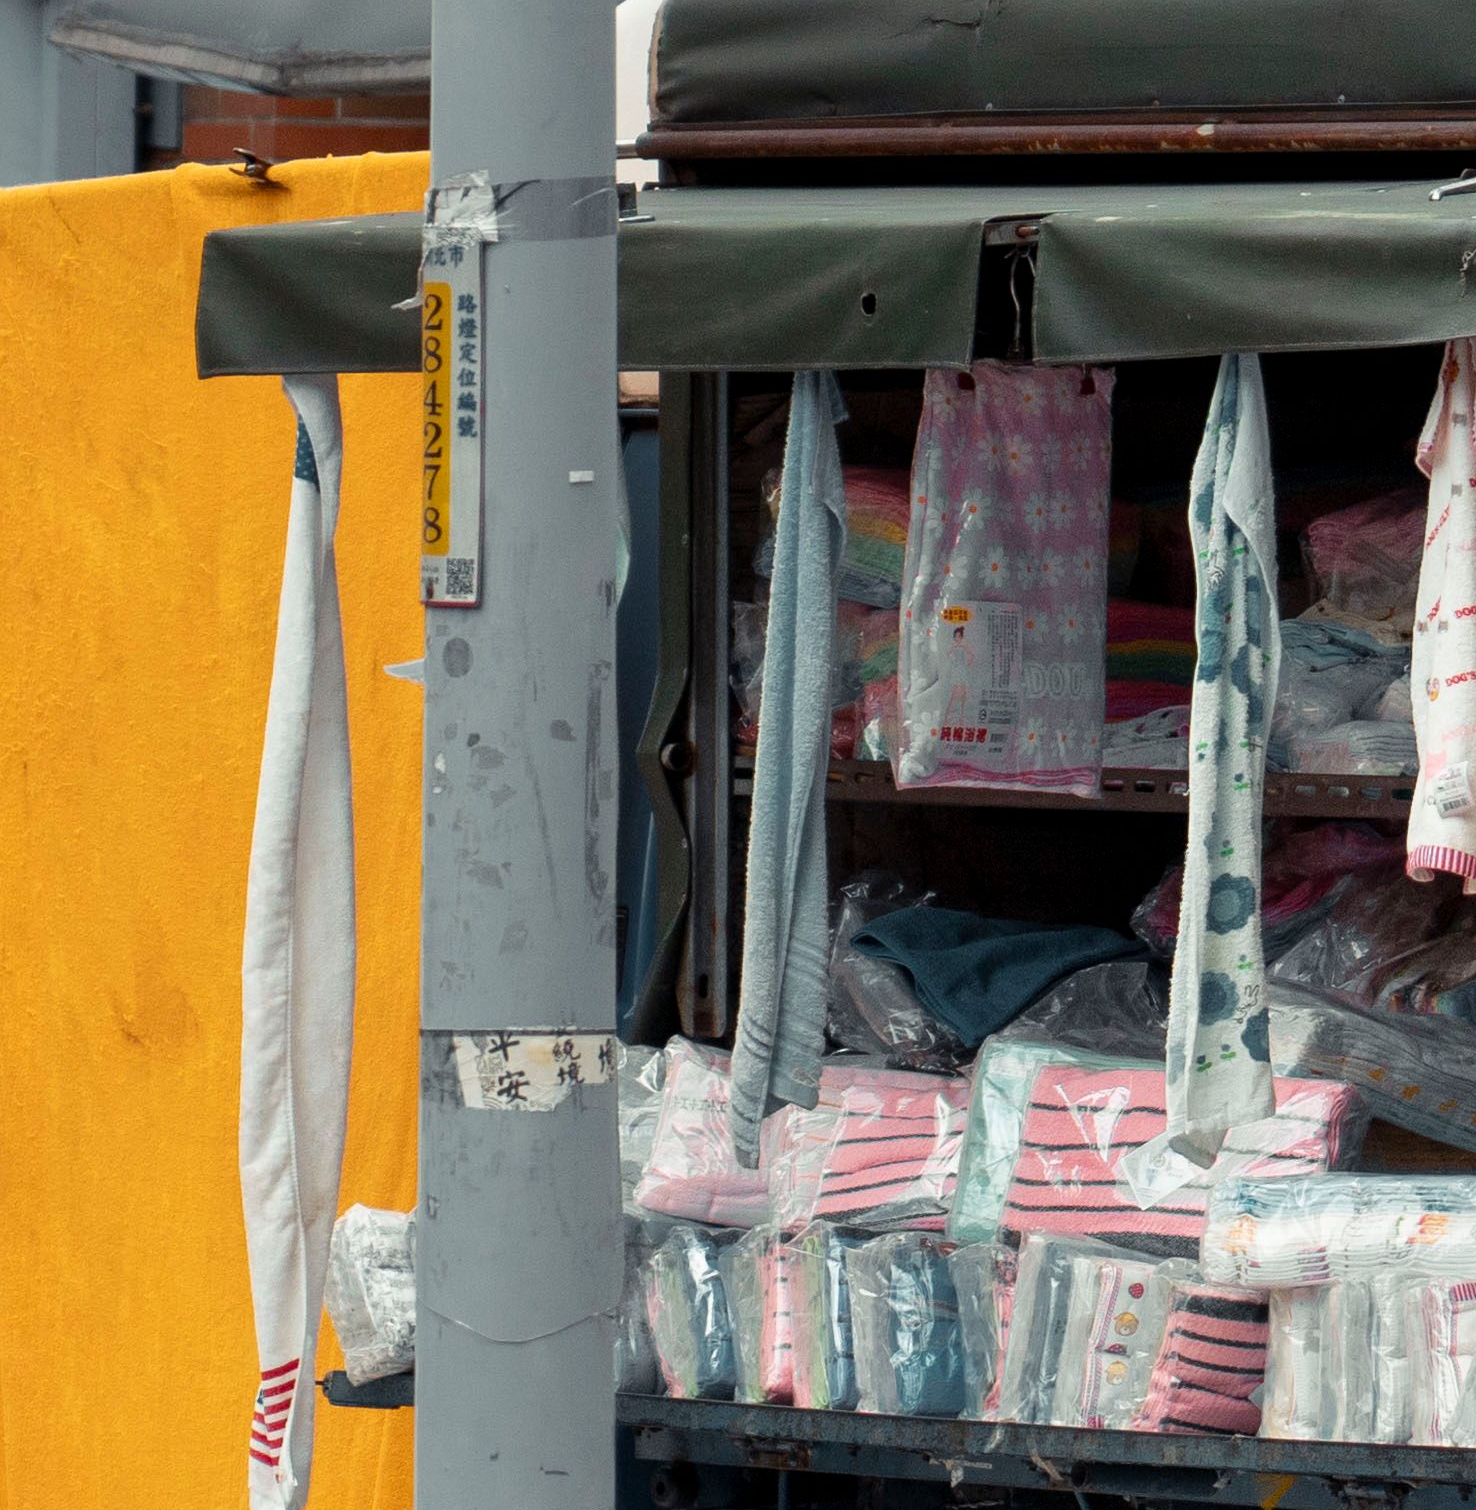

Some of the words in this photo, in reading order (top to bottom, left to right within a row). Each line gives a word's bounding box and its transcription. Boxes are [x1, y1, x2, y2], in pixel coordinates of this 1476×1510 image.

[423, 294, 444, 544] 284278
[457, 293, 478, 438] 路燈定位編號
